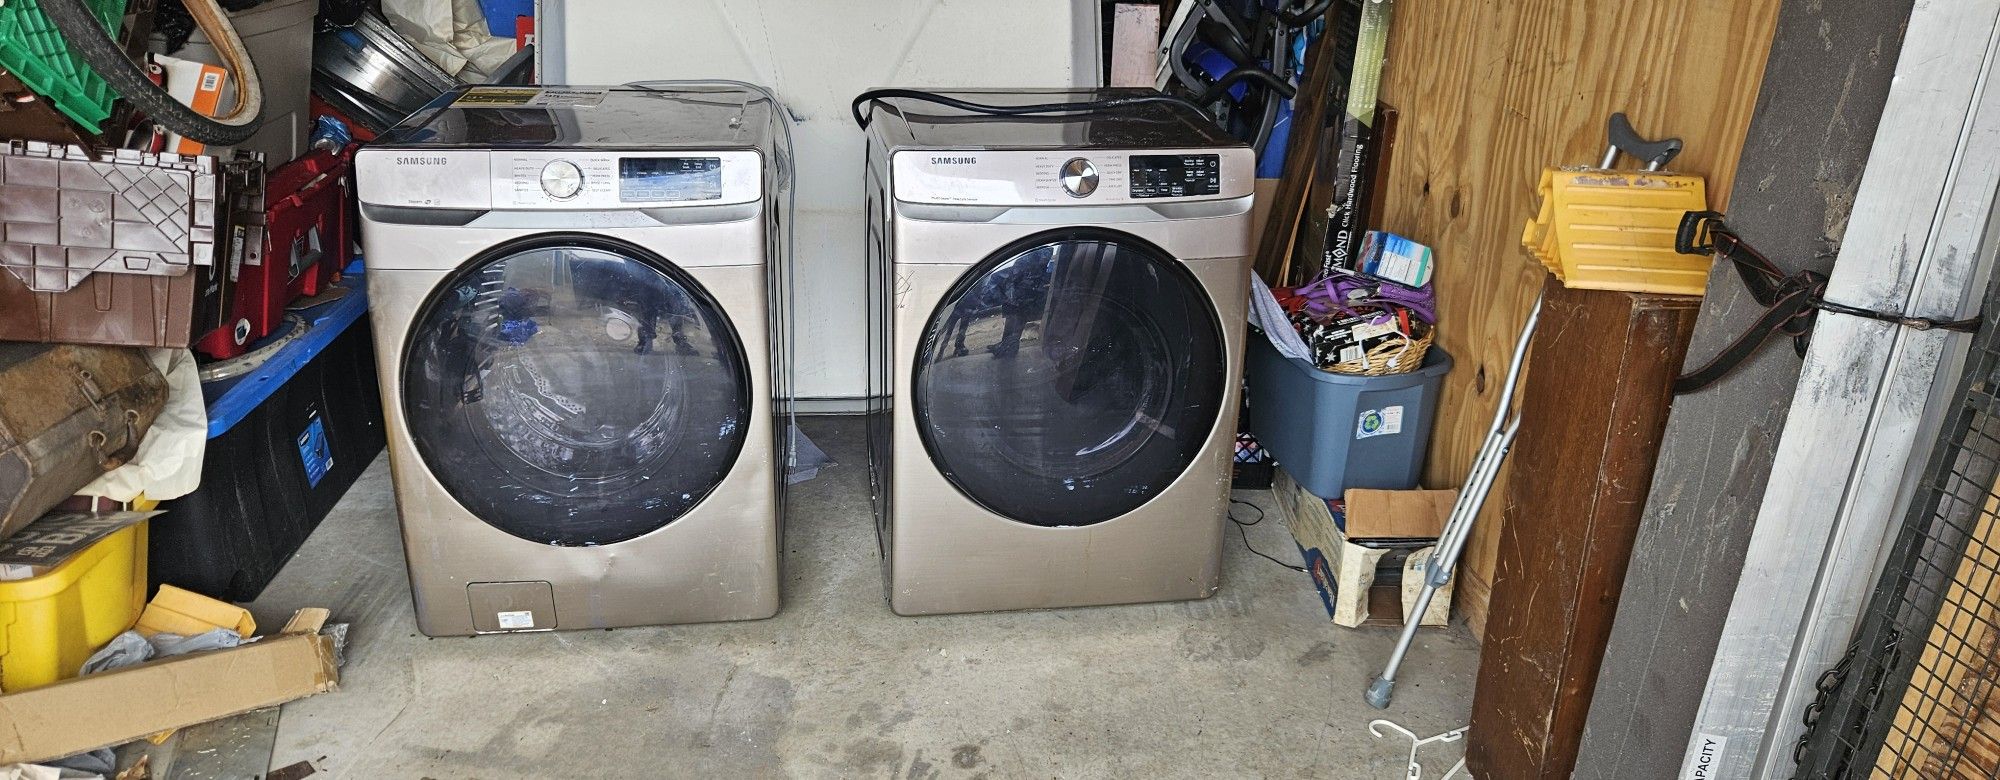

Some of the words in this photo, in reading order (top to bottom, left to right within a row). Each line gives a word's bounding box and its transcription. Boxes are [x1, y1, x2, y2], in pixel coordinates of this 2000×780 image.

[396, 157, 447, 166] SAMSUNG
[931, 157, 977, 165] SAMSUNG
[1351, 144, 1364, 173] Flooring
[1345, 174, 1358, 210] Hardwood
[1341, 210, 1351, 228] Click
